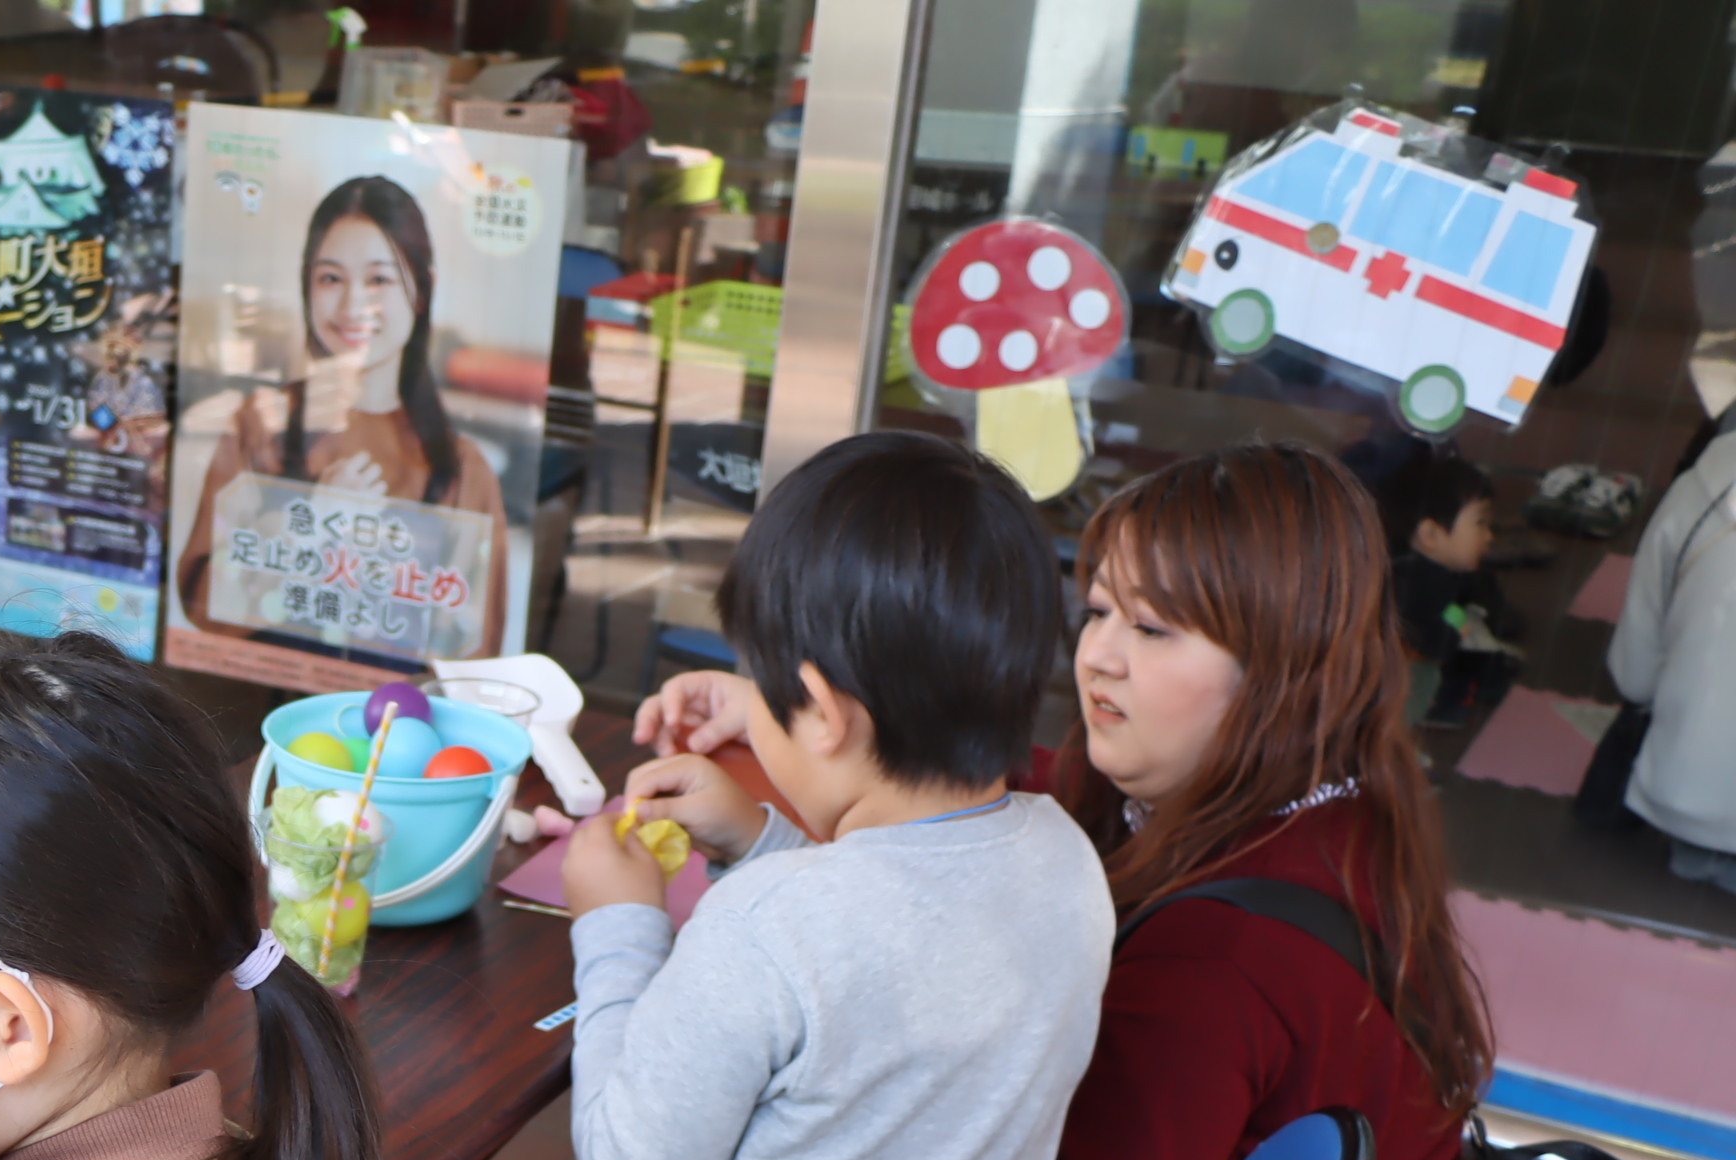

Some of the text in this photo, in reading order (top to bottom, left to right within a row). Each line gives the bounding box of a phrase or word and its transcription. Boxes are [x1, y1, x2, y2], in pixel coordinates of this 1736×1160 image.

[288, 503, 412, 553] 急ぐ日も
[231, 531, 468, 608] 足止め火を止め
[284, 584, 406, 635] 準備よし
